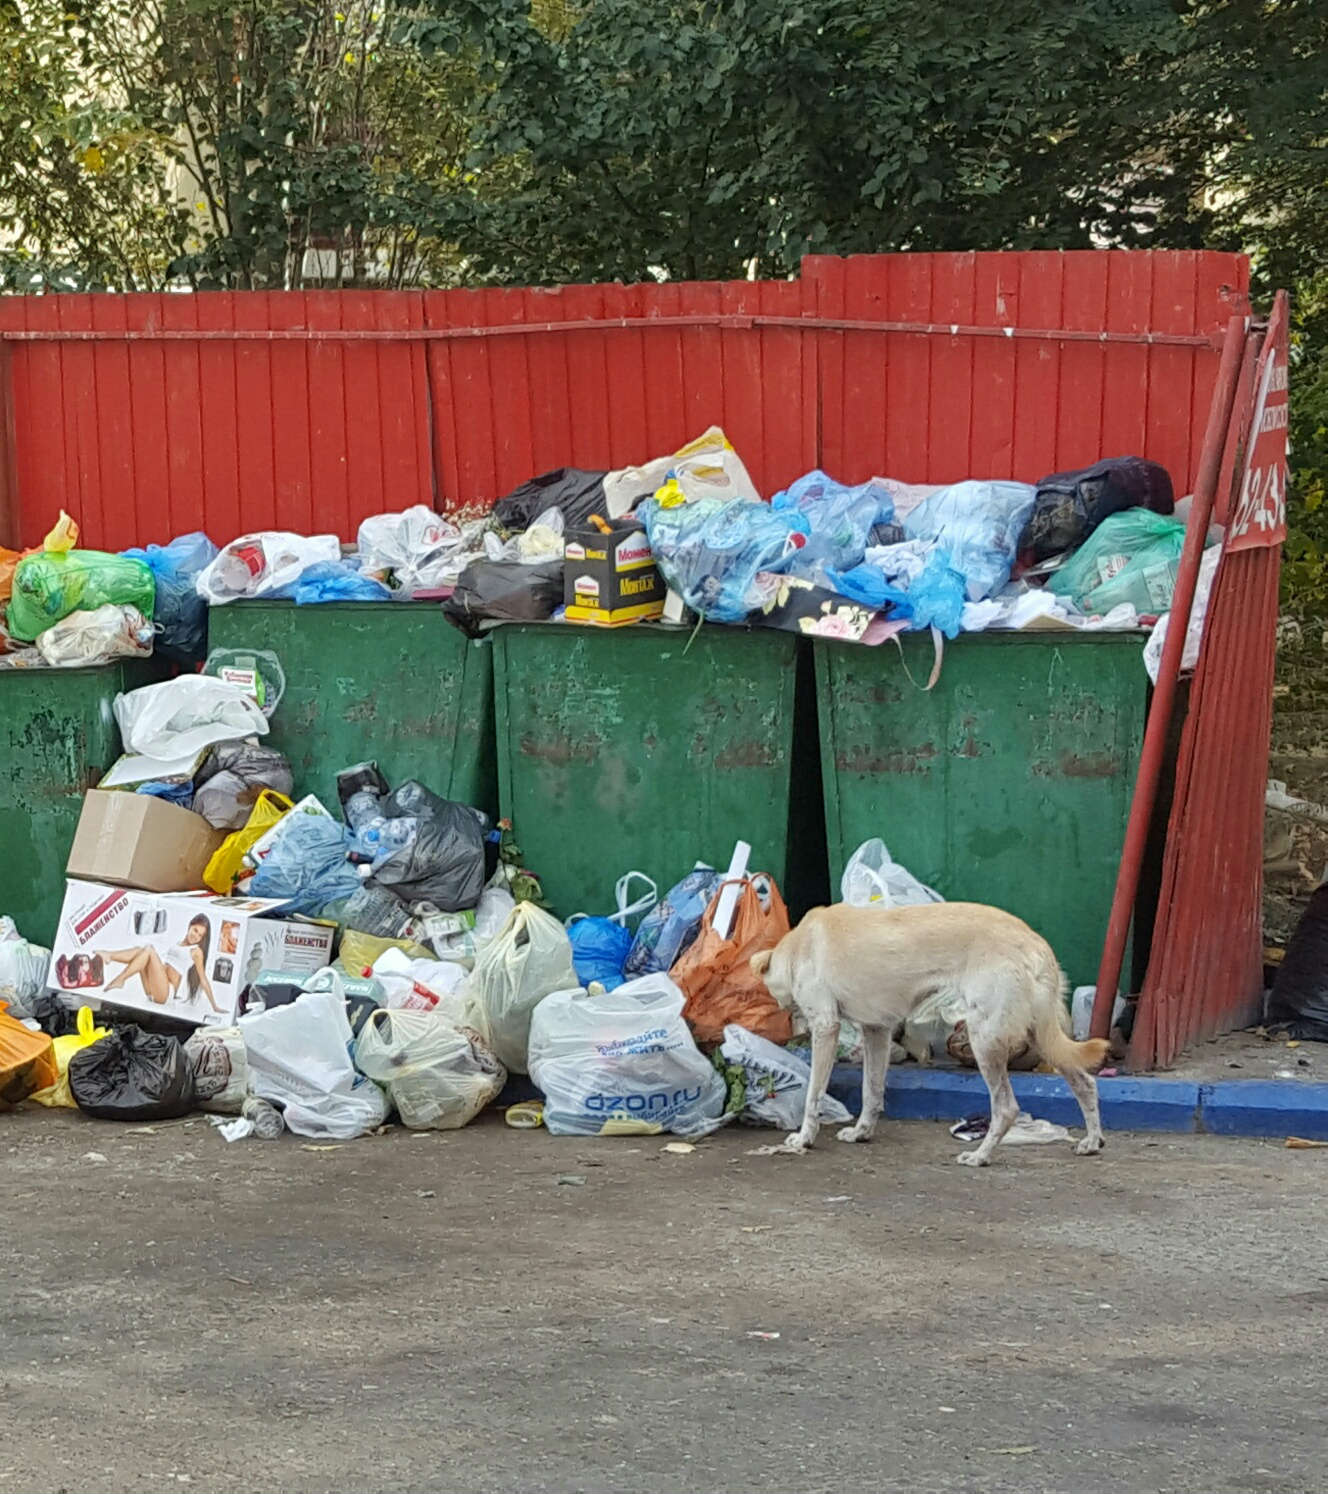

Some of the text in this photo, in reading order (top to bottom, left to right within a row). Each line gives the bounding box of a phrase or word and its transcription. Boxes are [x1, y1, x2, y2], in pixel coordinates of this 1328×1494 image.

[79, 897, 129, 945] БЛАЖЕНСТВО
[283, 934, 329, 949] БЛАЖЕНСТВО
[584, 1085, 701, 1111] ozon.ru
